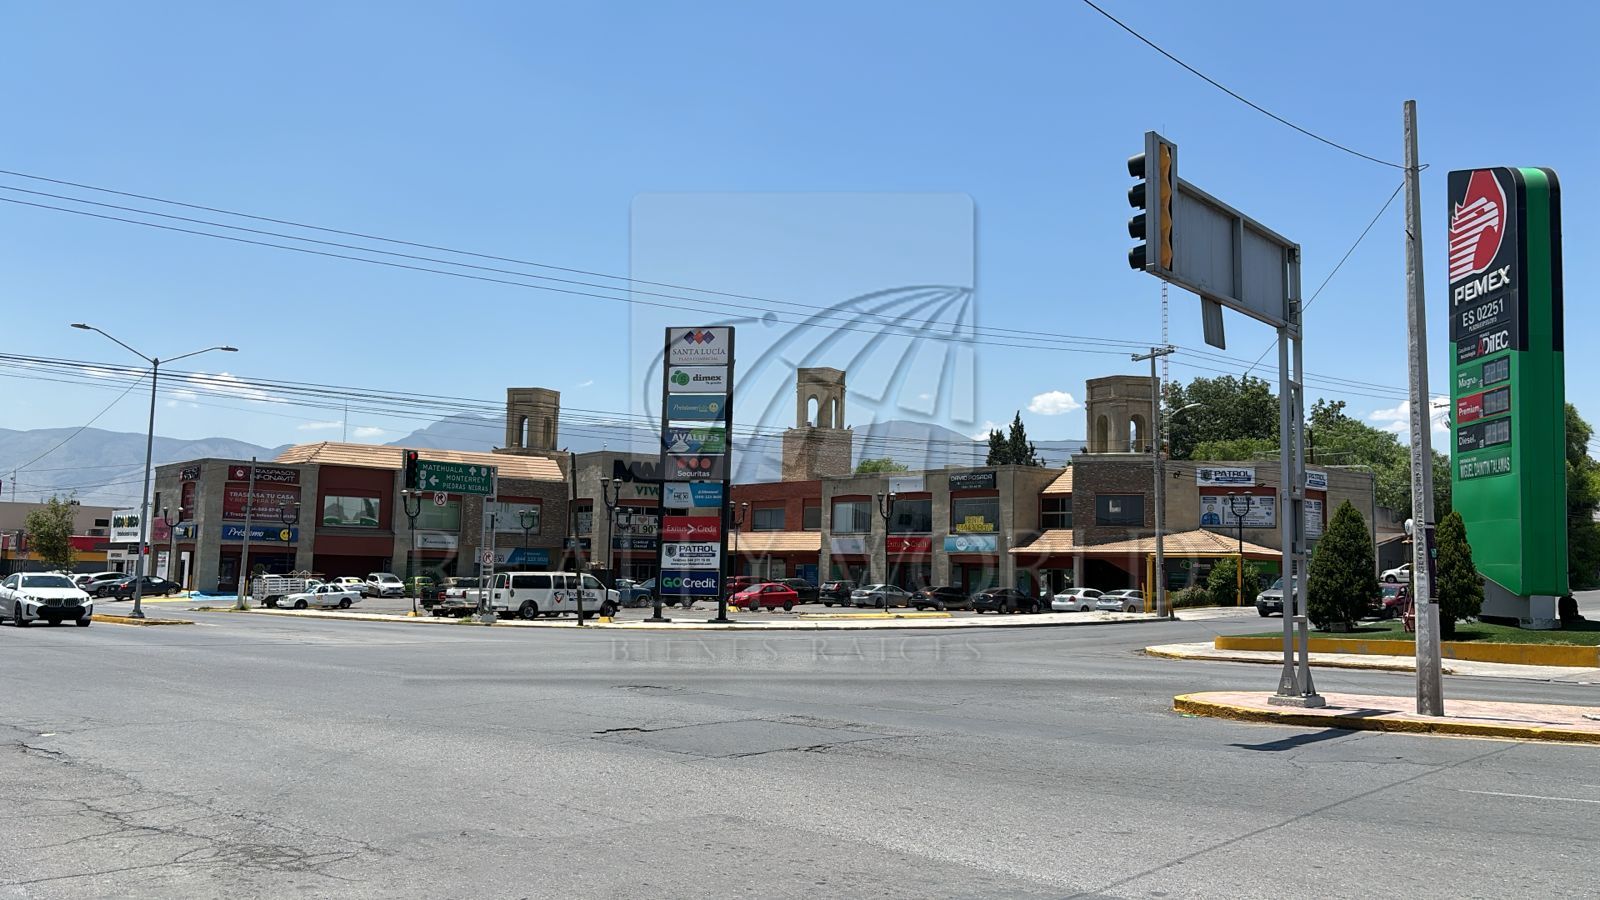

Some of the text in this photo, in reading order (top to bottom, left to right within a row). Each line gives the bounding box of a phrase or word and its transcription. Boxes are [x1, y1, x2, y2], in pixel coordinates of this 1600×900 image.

[1454, 264, 1511, 306] PEMEX
[1462, 298, 1504, 327] ES 02251
[672, 347, 726, 356] SANTA LUCÍA
[693, 374, 722, 382] dimex
[672, 433, 720, 442] AVALUOS
[255, 468, 295, 476] RASPASOS
[422, 463, 463, 473] MATEHUALA
[446, 474, 486, 484] MONTERREY
[442, 482, 489, 492] PIEDRAS NEGRAS
[230, 491, 265, 499] TRASASA
[697, 524, 717, 532] Credit
[679, 545, 717, 553] PATROL
